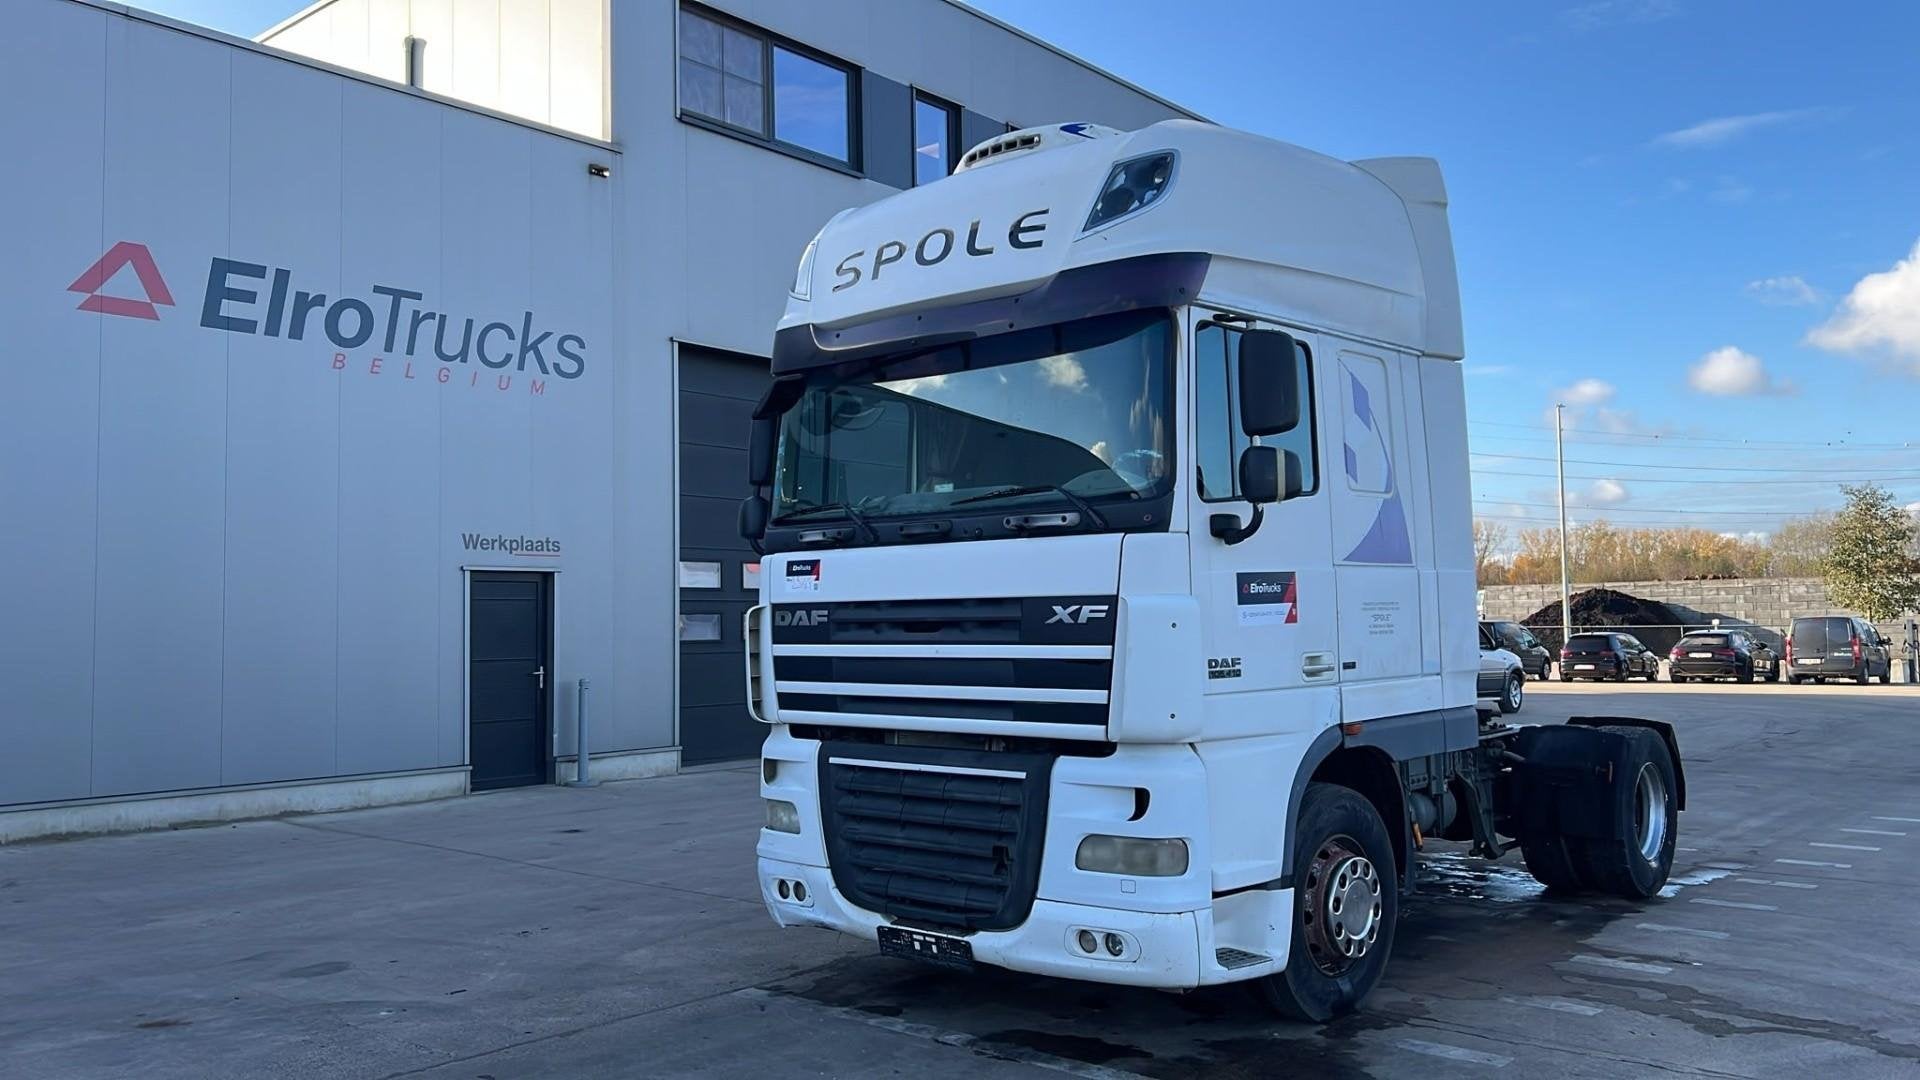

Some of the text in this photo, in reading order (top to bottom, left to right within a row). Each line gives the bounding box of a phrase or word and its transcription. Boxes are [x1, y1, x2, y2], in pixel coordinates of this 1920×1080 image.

[831, 208, 1049, 292] SPOLE
[200, 257, 586, 379] ElroTrucks
[333, 353, 546, 395] BELGIUM
[462, 533, 560, 554] Werkplaats
[1250, 583, 1281, 594] ElroTrucks
[775, 610, 828, 626] DAF
[1044, 605, 1109, 624] XF
[1208, 657, 1241, 669] DAF
